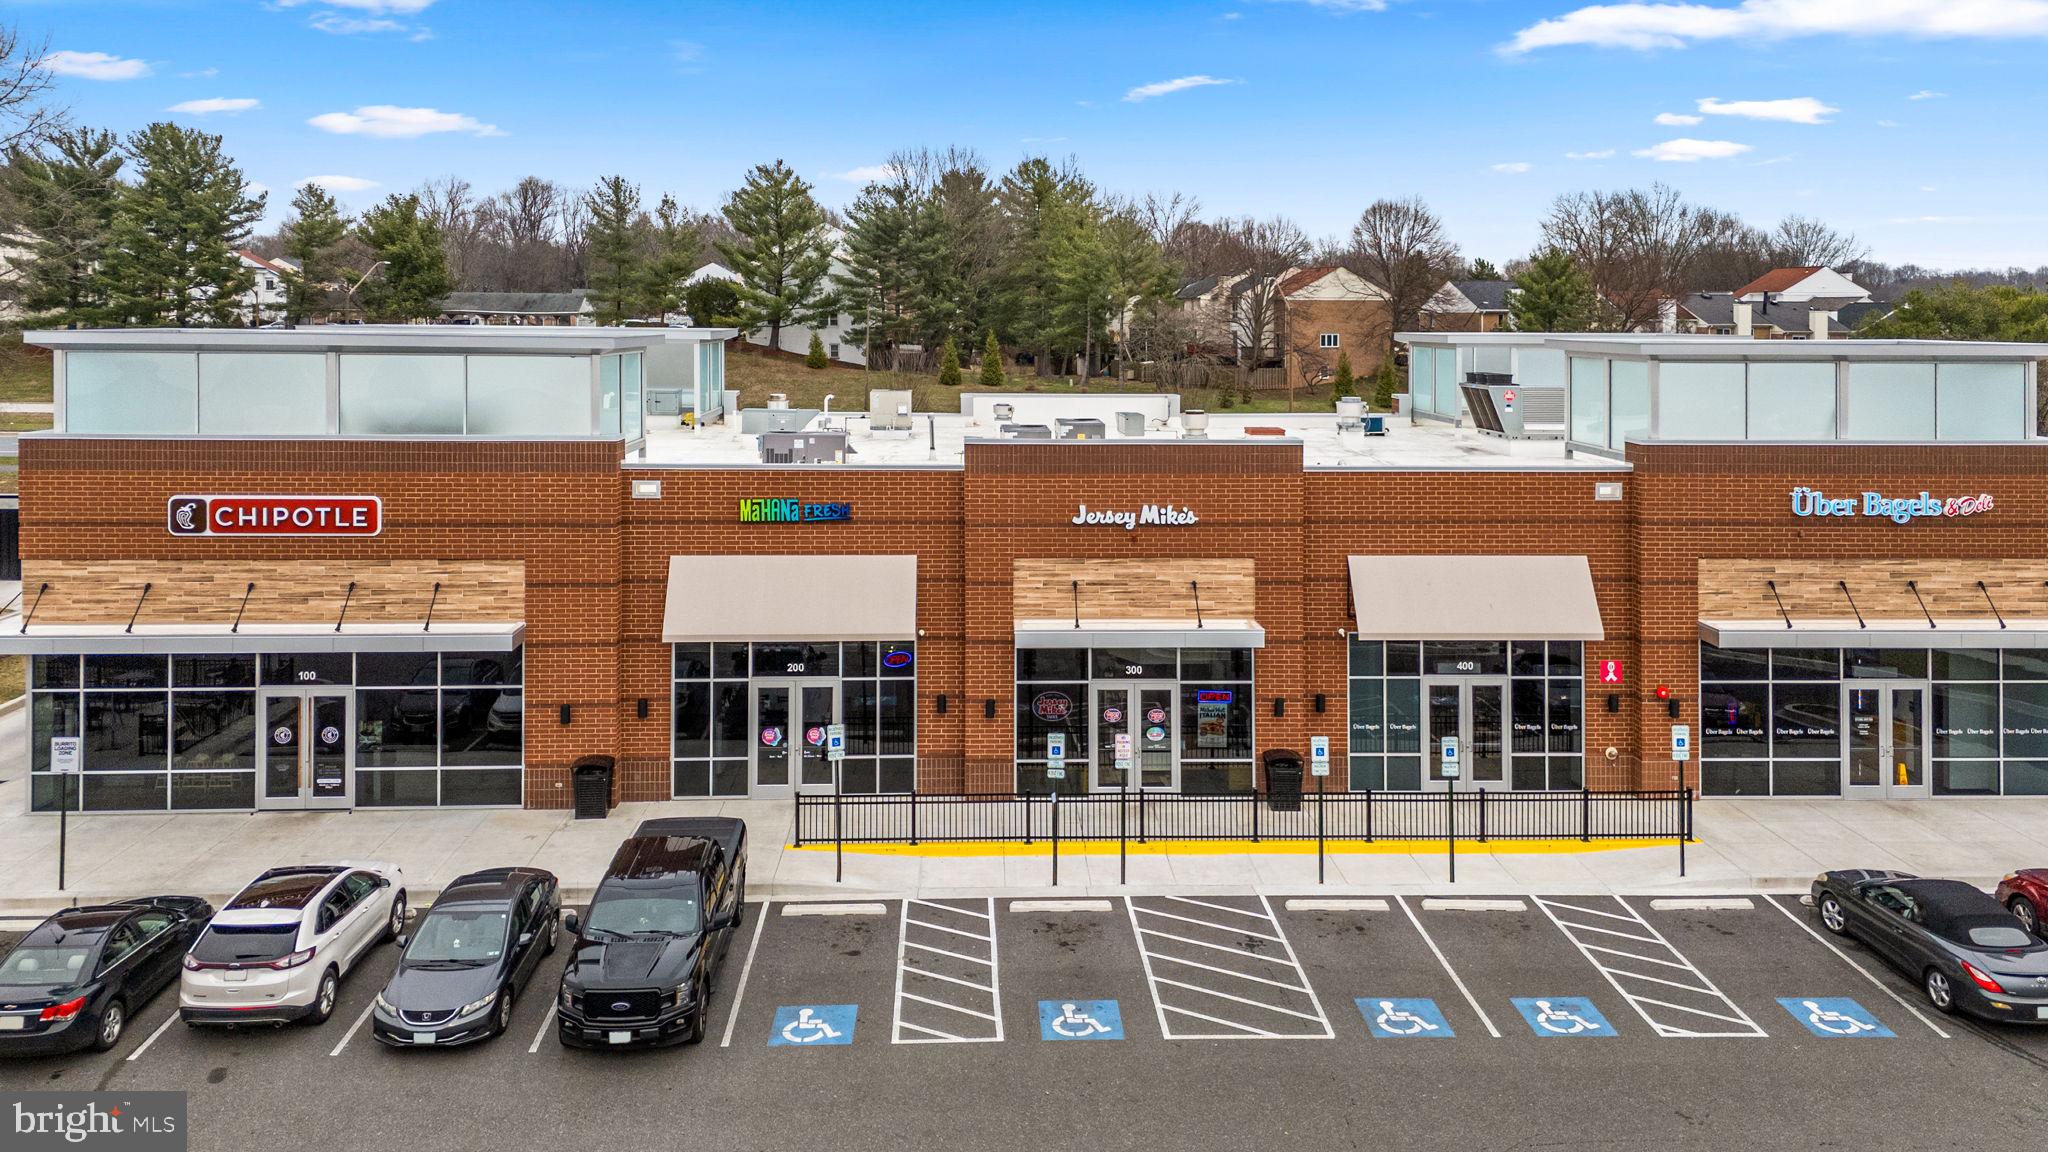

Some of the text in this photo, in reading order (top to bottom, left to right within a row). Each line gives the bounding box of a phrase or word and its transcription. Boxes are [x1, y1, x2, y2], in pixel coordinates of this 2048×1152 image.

[1790, 486, 1995, 524] Über Bagels & Deli
[214, 506, 369, 527] CHIPOTLE
[803, 503, 850, 520] FRESH
[1072, 504, 1199, 530] Jersey Mike's
[787, 663, 804, 672] 200
[1125, 665, 1143, 675] 300
[1456, 661, 1474, 671] 400
[298, 671, 316, 680] 100
[1200, 692, 1231, 701] OPEN
